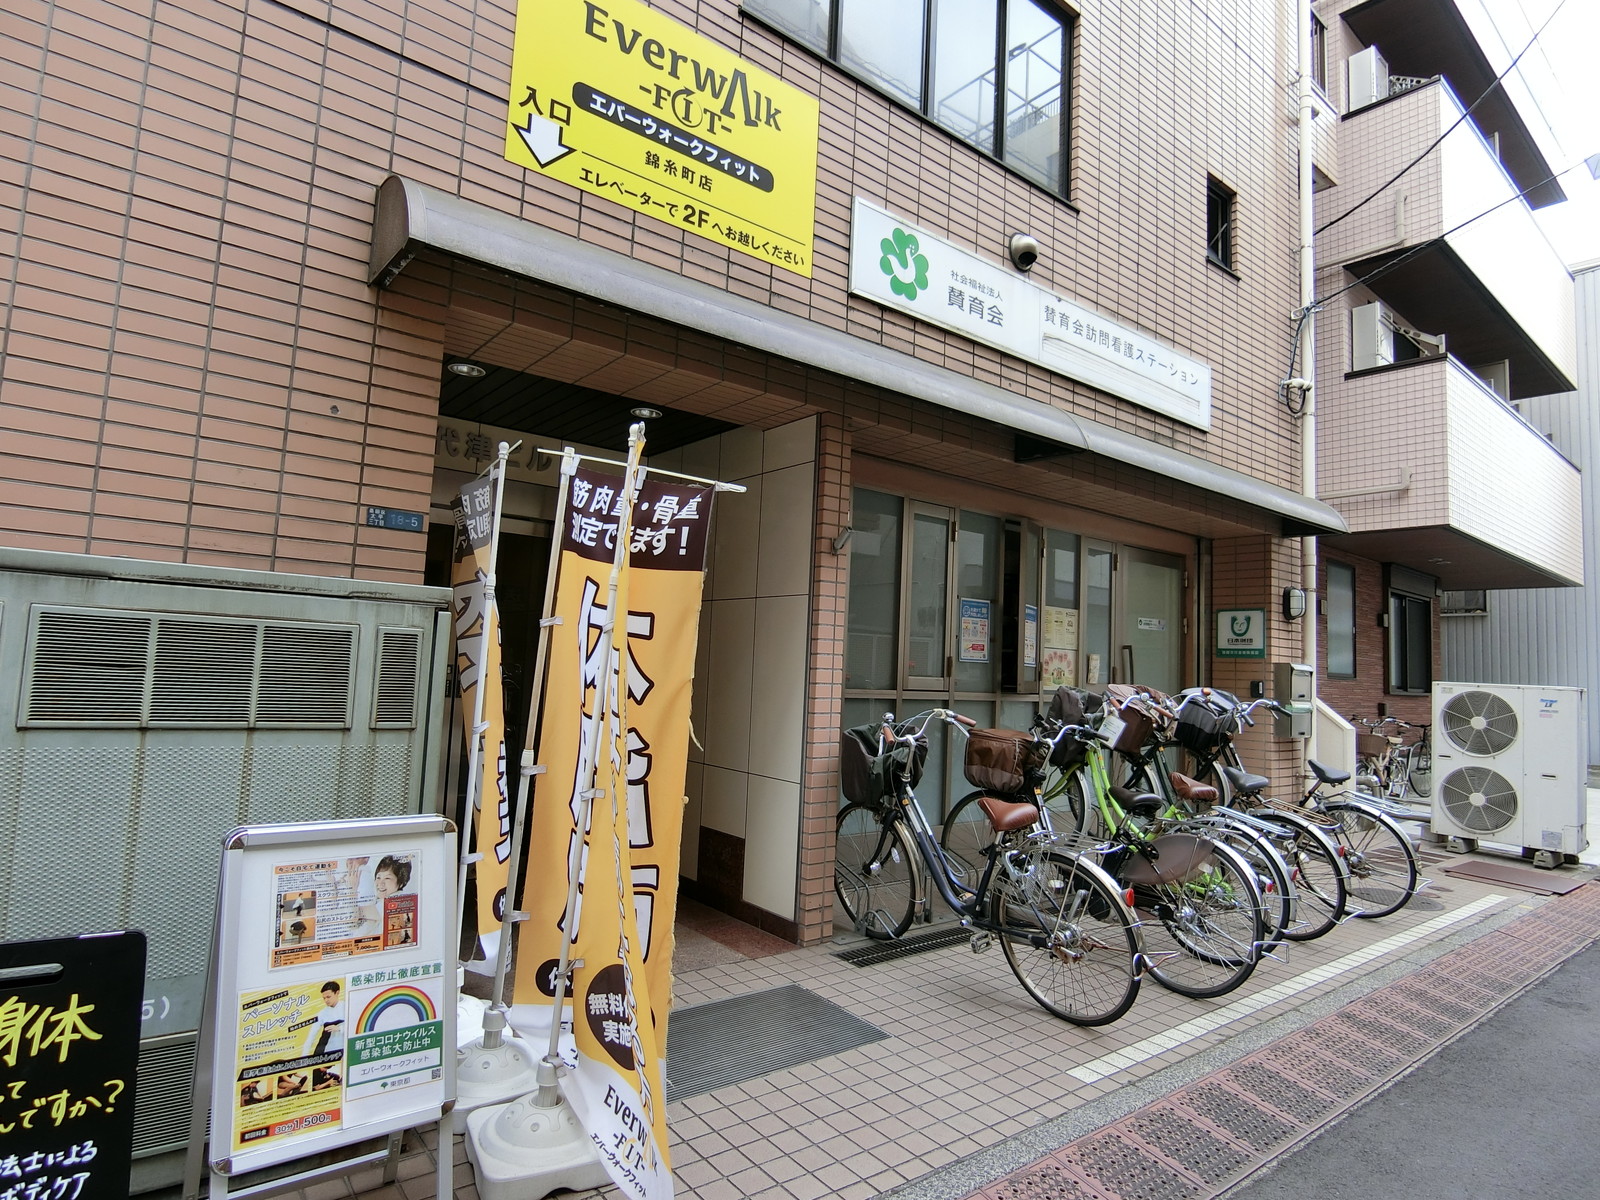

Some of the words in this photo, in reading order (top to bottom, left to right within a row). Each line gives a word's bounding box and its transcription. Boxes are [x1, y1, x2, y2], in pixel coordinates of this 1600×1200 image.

[519, 85, 571, 125] 入口
[590, 93, 760, 182] エバーウォークフィット
[645, 150, 713, 192] 錦糸町店
[950, 270, 1003, 302] 社会福祉法人
[947, 285, 1004, 327] 賛育会
[1044, 304, 1199, 385] 賛育会訪問看護ステーション
[391, 513, 418, 527] 18-5
[571, 511, 690, 556] 測定でます！
[351, 963, 442, 987] 感染防止徹底宣言
[242, 1009, 302, 1038] ストレッチ
[243, 995, 310, 1022] パーソナル
[355, 1026, 436, 1051] 新型コロナウイルス
[360, 1037, 431, 1060] 感染拡大防止中
[361, 1055, 430, 1076] エバーウォークフィット
[390, 1077, 411, 1087] 東京都
[590, 1132, 647, 1198] エバーウォークフィット
